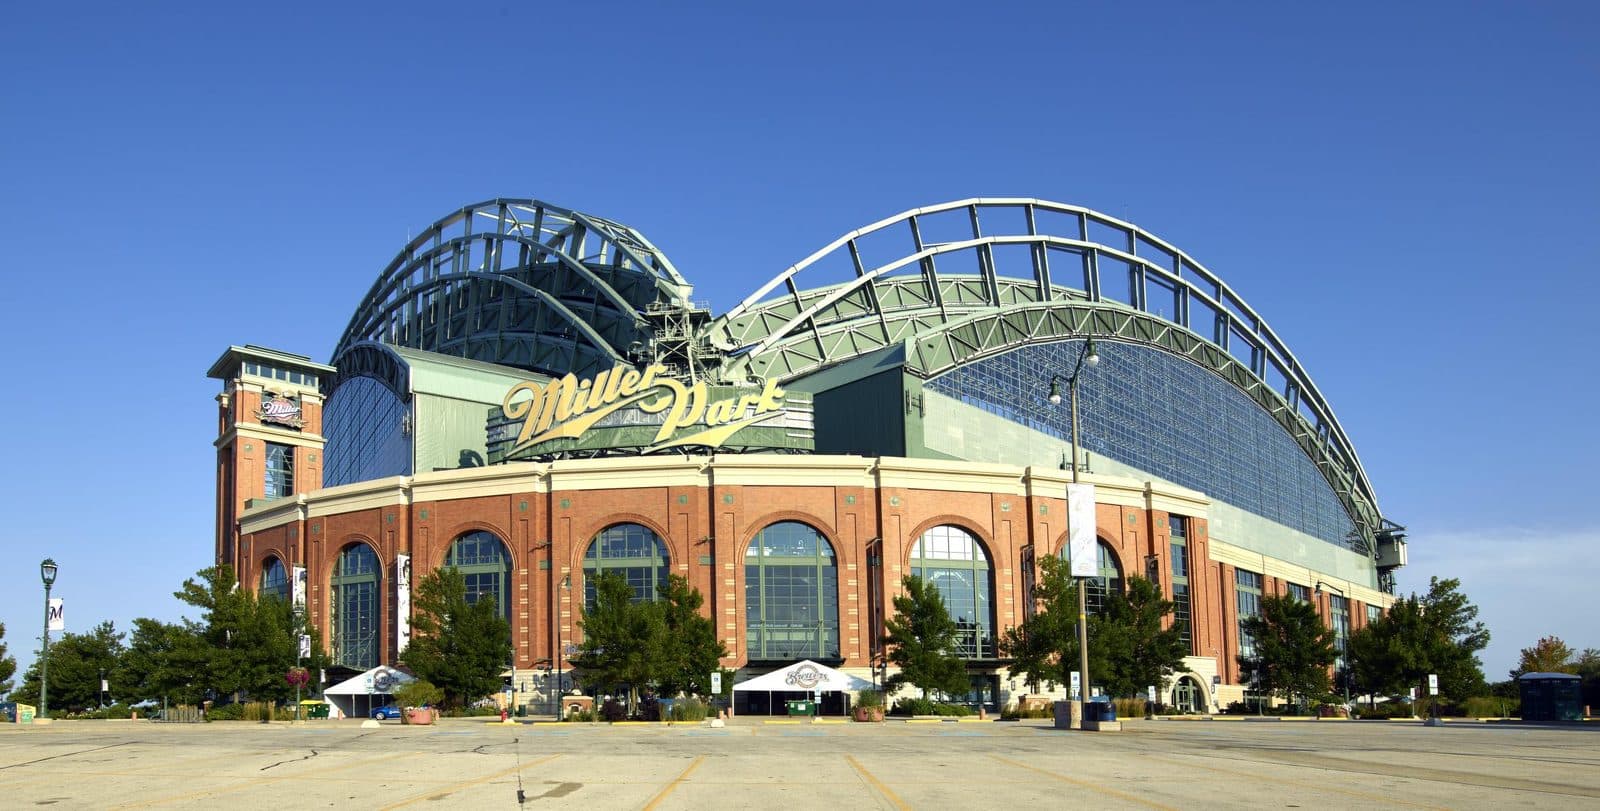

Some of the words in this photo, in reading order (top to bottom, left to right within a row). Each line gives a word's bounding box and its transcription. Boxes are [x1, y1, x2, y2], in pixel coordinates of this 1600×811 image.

[262, 401, 301, 415] Miller
[503, 363, 668, 447] Miller
[638, 377, 786, 444] Park
